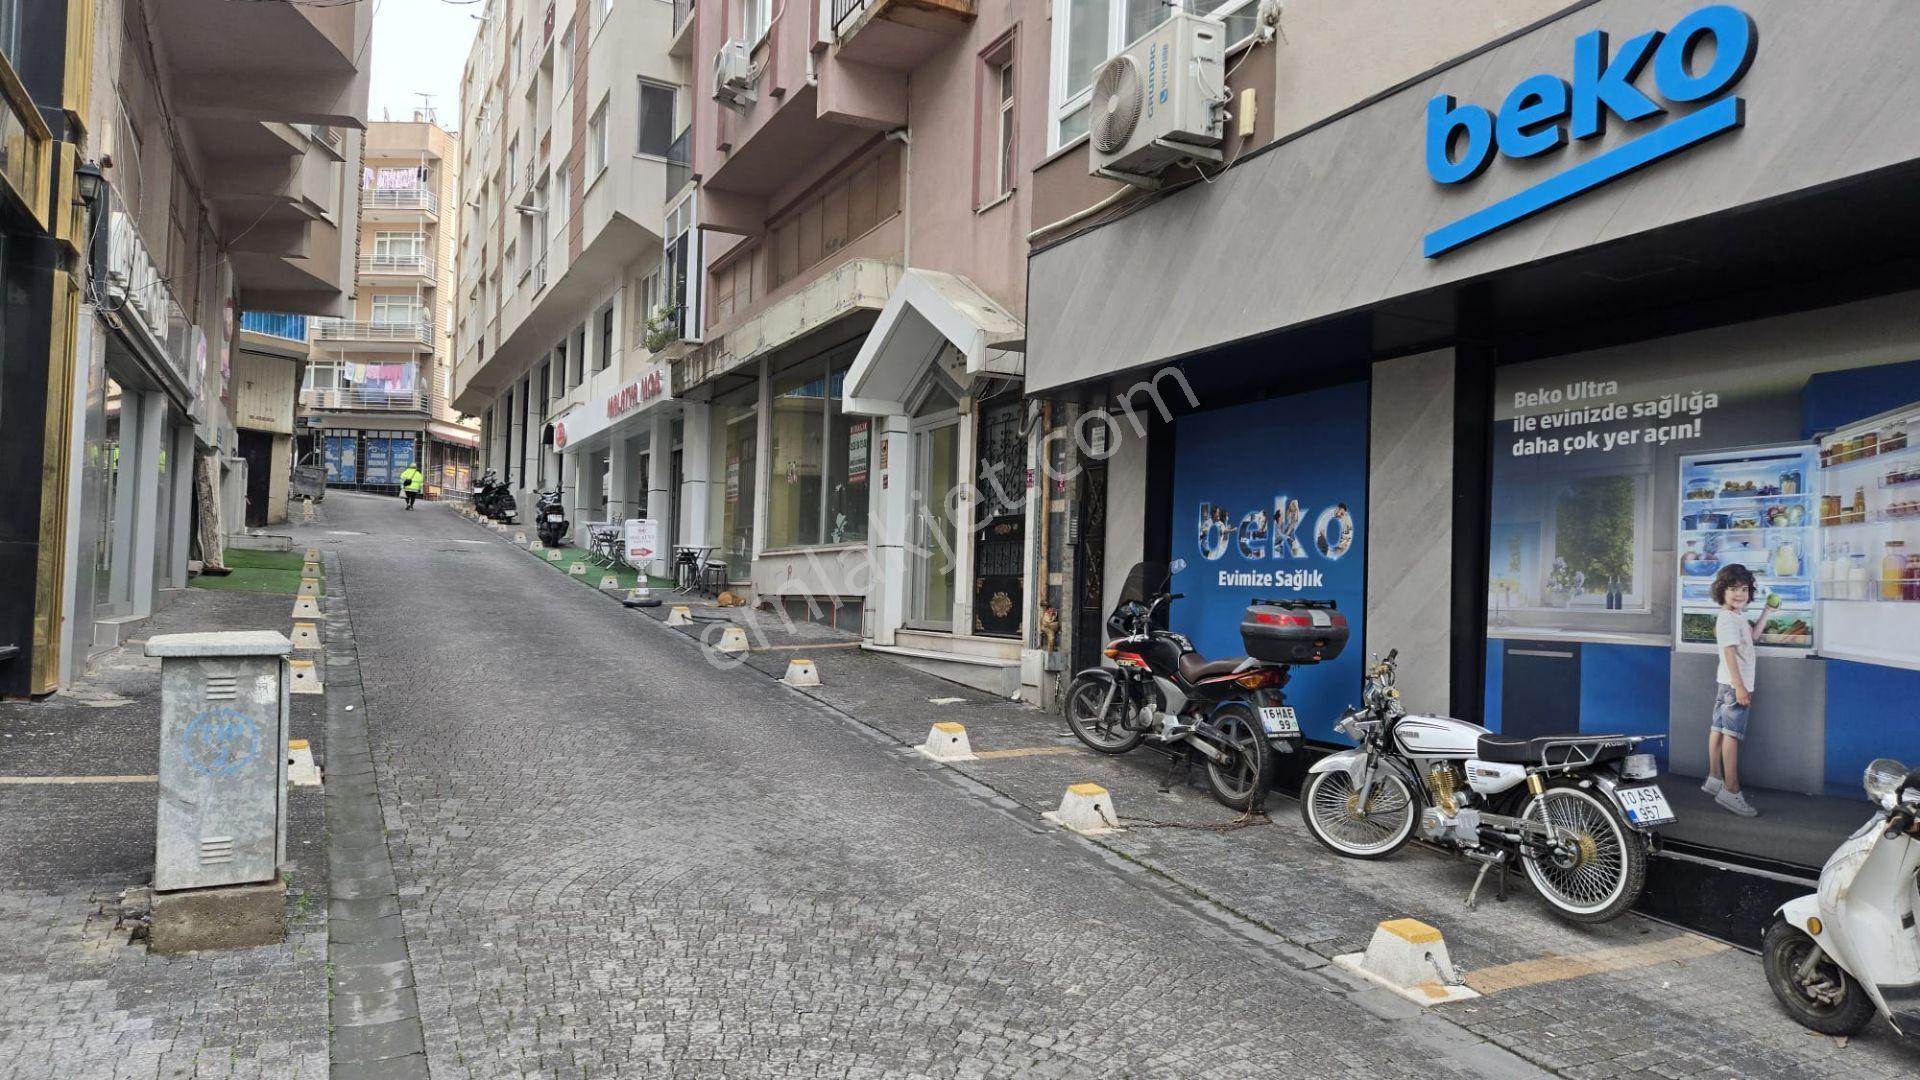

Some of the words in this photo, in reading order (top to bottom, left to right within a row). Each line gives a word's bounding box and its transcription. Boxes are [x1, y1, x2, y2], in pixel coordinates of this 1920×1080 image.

[1426, 4, 1757, 184] beko
[1514, 387, 1562, 408] Beko
[1567, 380, 1618, 401] Ultra
[1513, 415, 1536, 432] ile
[1540, 403, 1627, 429] evinizde
[1632, 390, 1718, 419] sağlığa
[1512, 438, 1559, 456] daha
[1563, 431, 1598, 456] çok
[1603, 429, 1640, 452] yer
[1644, 418, 1701, 446] açın!
[1198, 495, 1354, 561] beko
[1218, 569, 1272, 587] Evimize
[1275, 569, 1323, 592] Sağlık
[1279, 720, 1290, 730] 99
[1621, 791, 1636, 805] 10
[1637, 788, 1661, 802] ASA
[1639, 805, 1660, 820] 957
